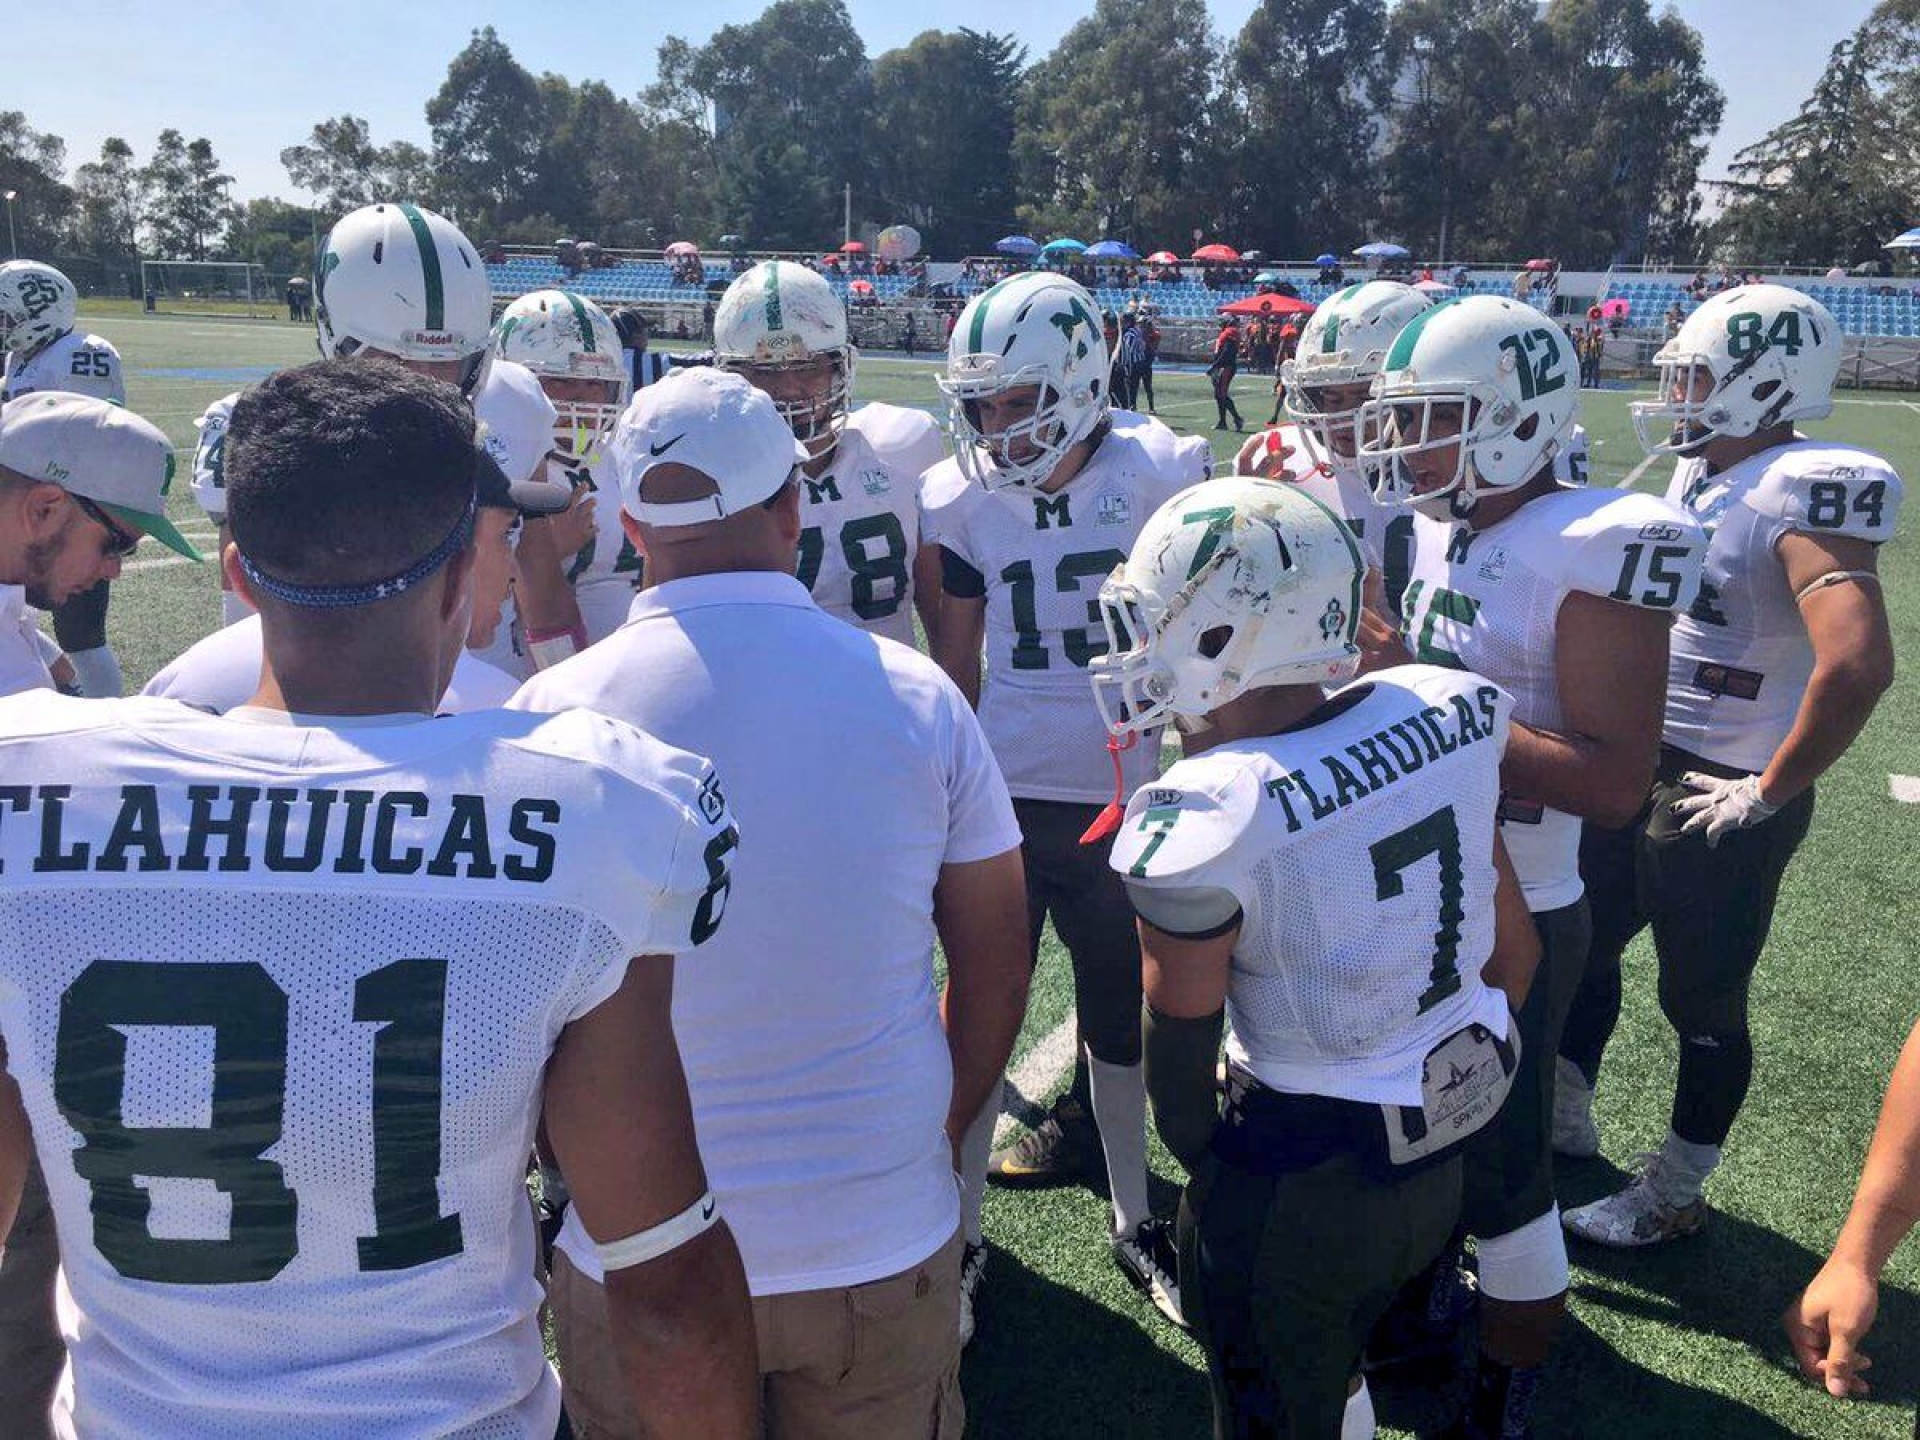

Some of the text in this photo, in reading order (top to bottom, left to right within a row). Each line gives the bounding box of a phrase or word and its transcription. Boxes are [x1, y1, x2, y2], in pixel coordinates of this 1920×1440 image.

[71, 351, 110, 377] 25
[1499, 328, 1567, 401] 12
[1727, 311, 1803, 358] 84
[803, 475, 843, 505] M
[1033, 493, 1073, 530] M
[1807, 480, 1886, 528] 84
[1445, 527, 1482, 565] M
[1608, 542, 1691, 607] 15
[1001, 548, 1133, 669] 13
[1263, 686, 1500, 833] TLAHUICAS
[1129, 808, 1182, 878] 7
[1368, 804, 1465, 1017] 7
[54, 959, 465, 1286] 81
